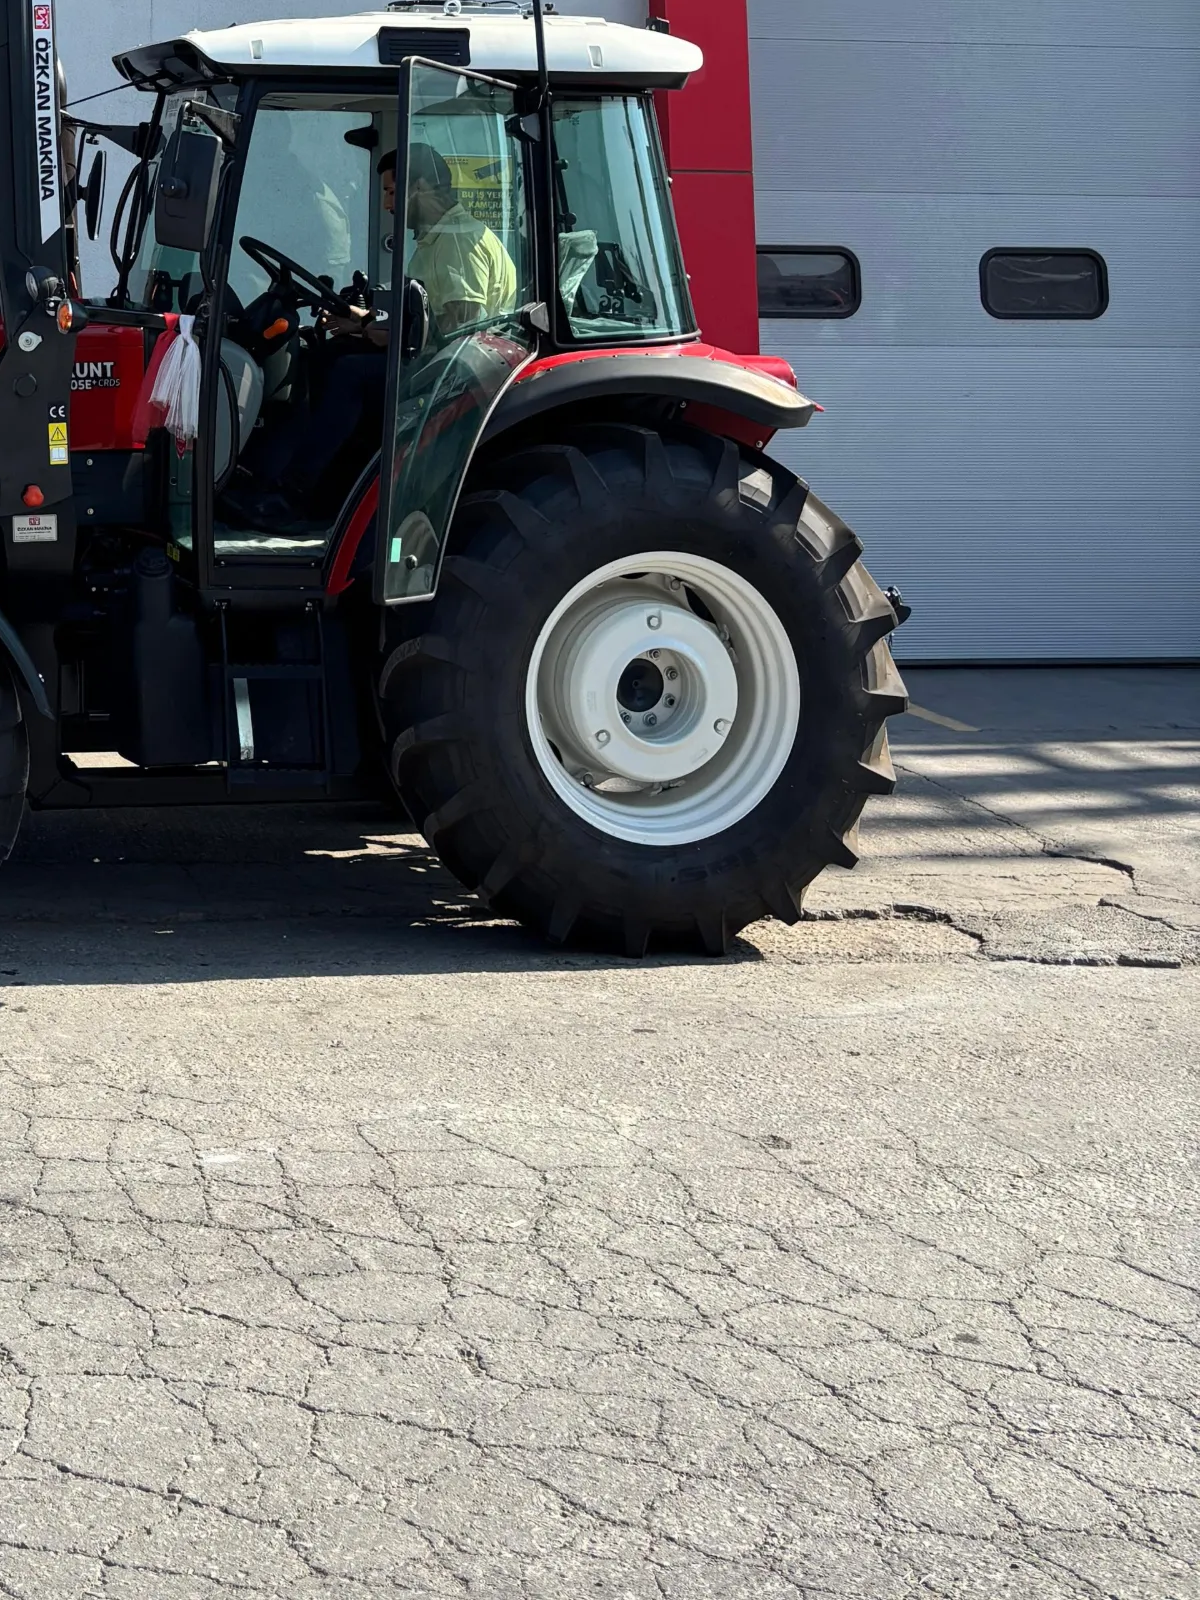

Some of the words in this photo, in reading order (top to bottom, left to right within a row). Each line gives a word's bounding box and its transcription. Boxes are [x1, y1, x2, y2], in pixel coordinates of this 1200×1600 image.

[35, 37, 51, 111] ÖZKAN
[37, 116, 56, 201] MAKİNA
[71, 361, 115, 378] UNT
[98, 378, 121, 387] CRDS
[49, 405, 66, 418] CE
